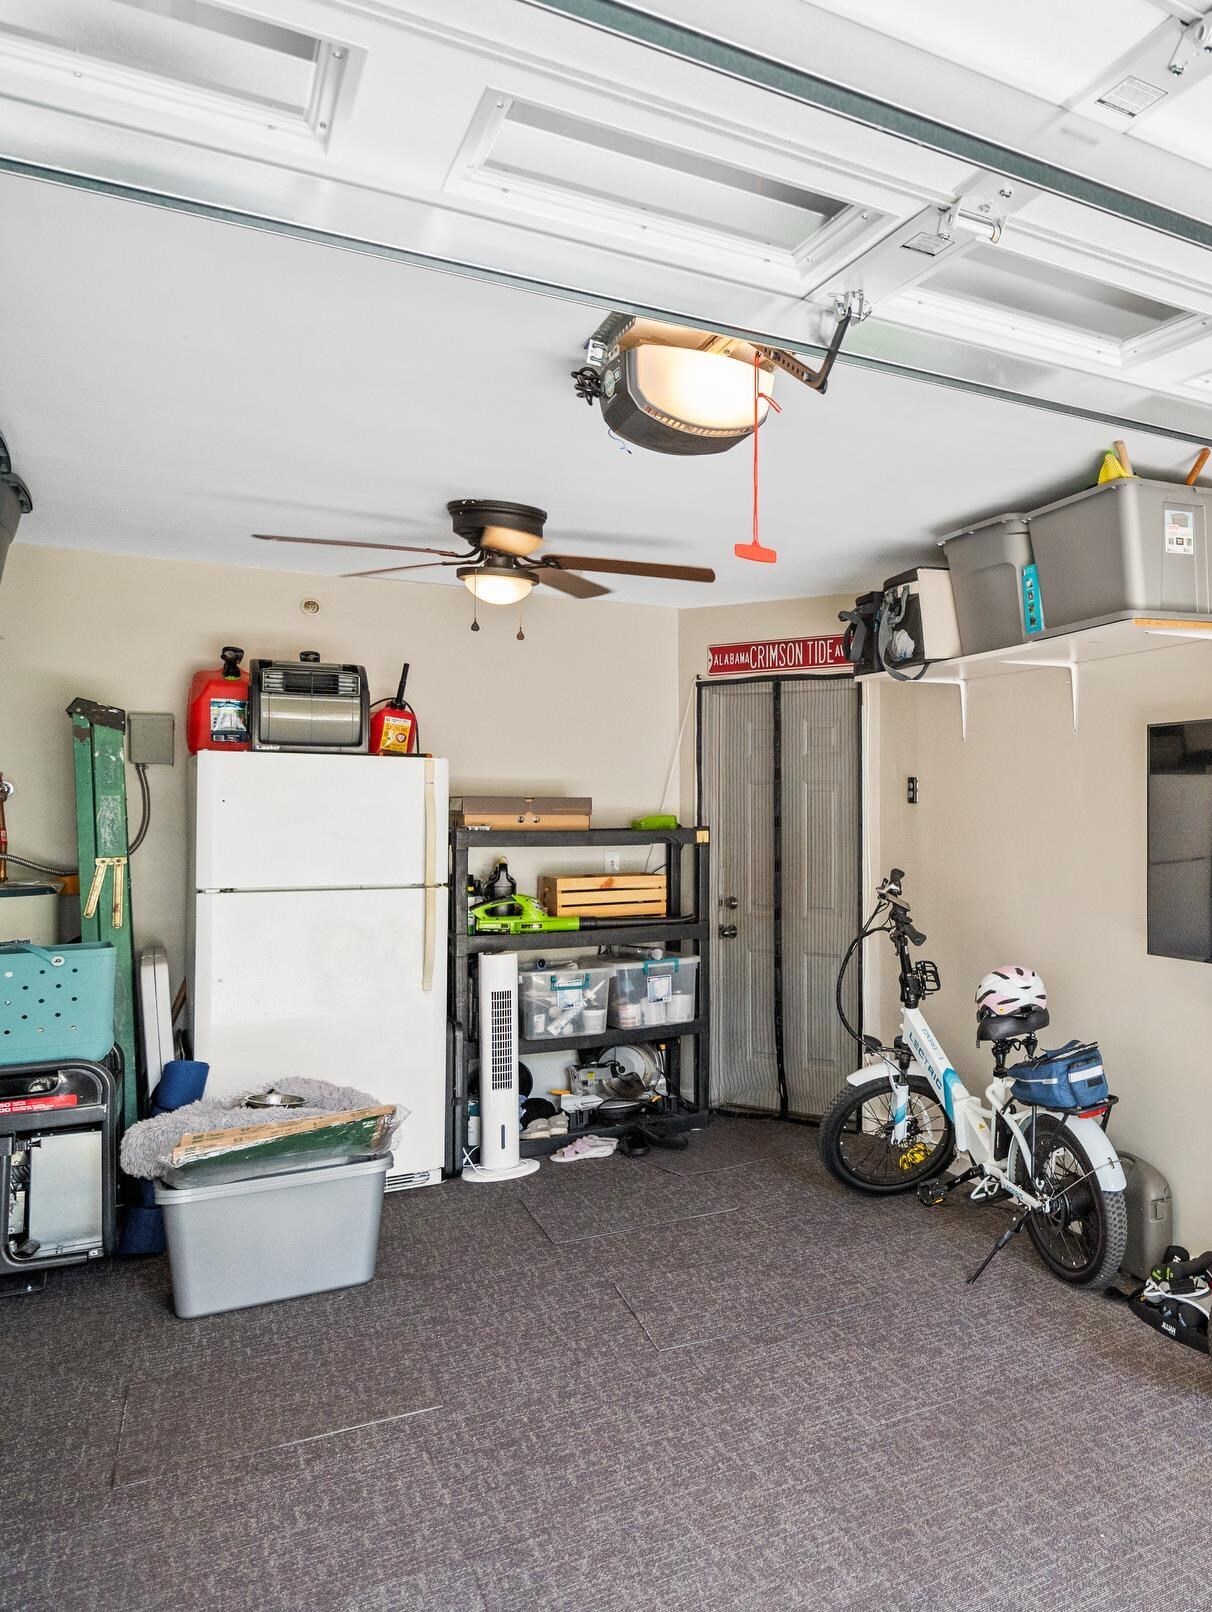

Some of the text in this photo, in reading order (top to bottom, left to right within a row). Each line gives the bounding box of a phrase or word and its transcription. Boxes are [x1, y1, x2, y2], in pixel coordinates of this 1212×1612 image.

[713, 650, 750, 667] ALABAMA
[749, 642, 804, 669] CRIMSON
[807, 639, 835, 665] TIDE
[909, 1032, 942, 1090] LECTRIC
